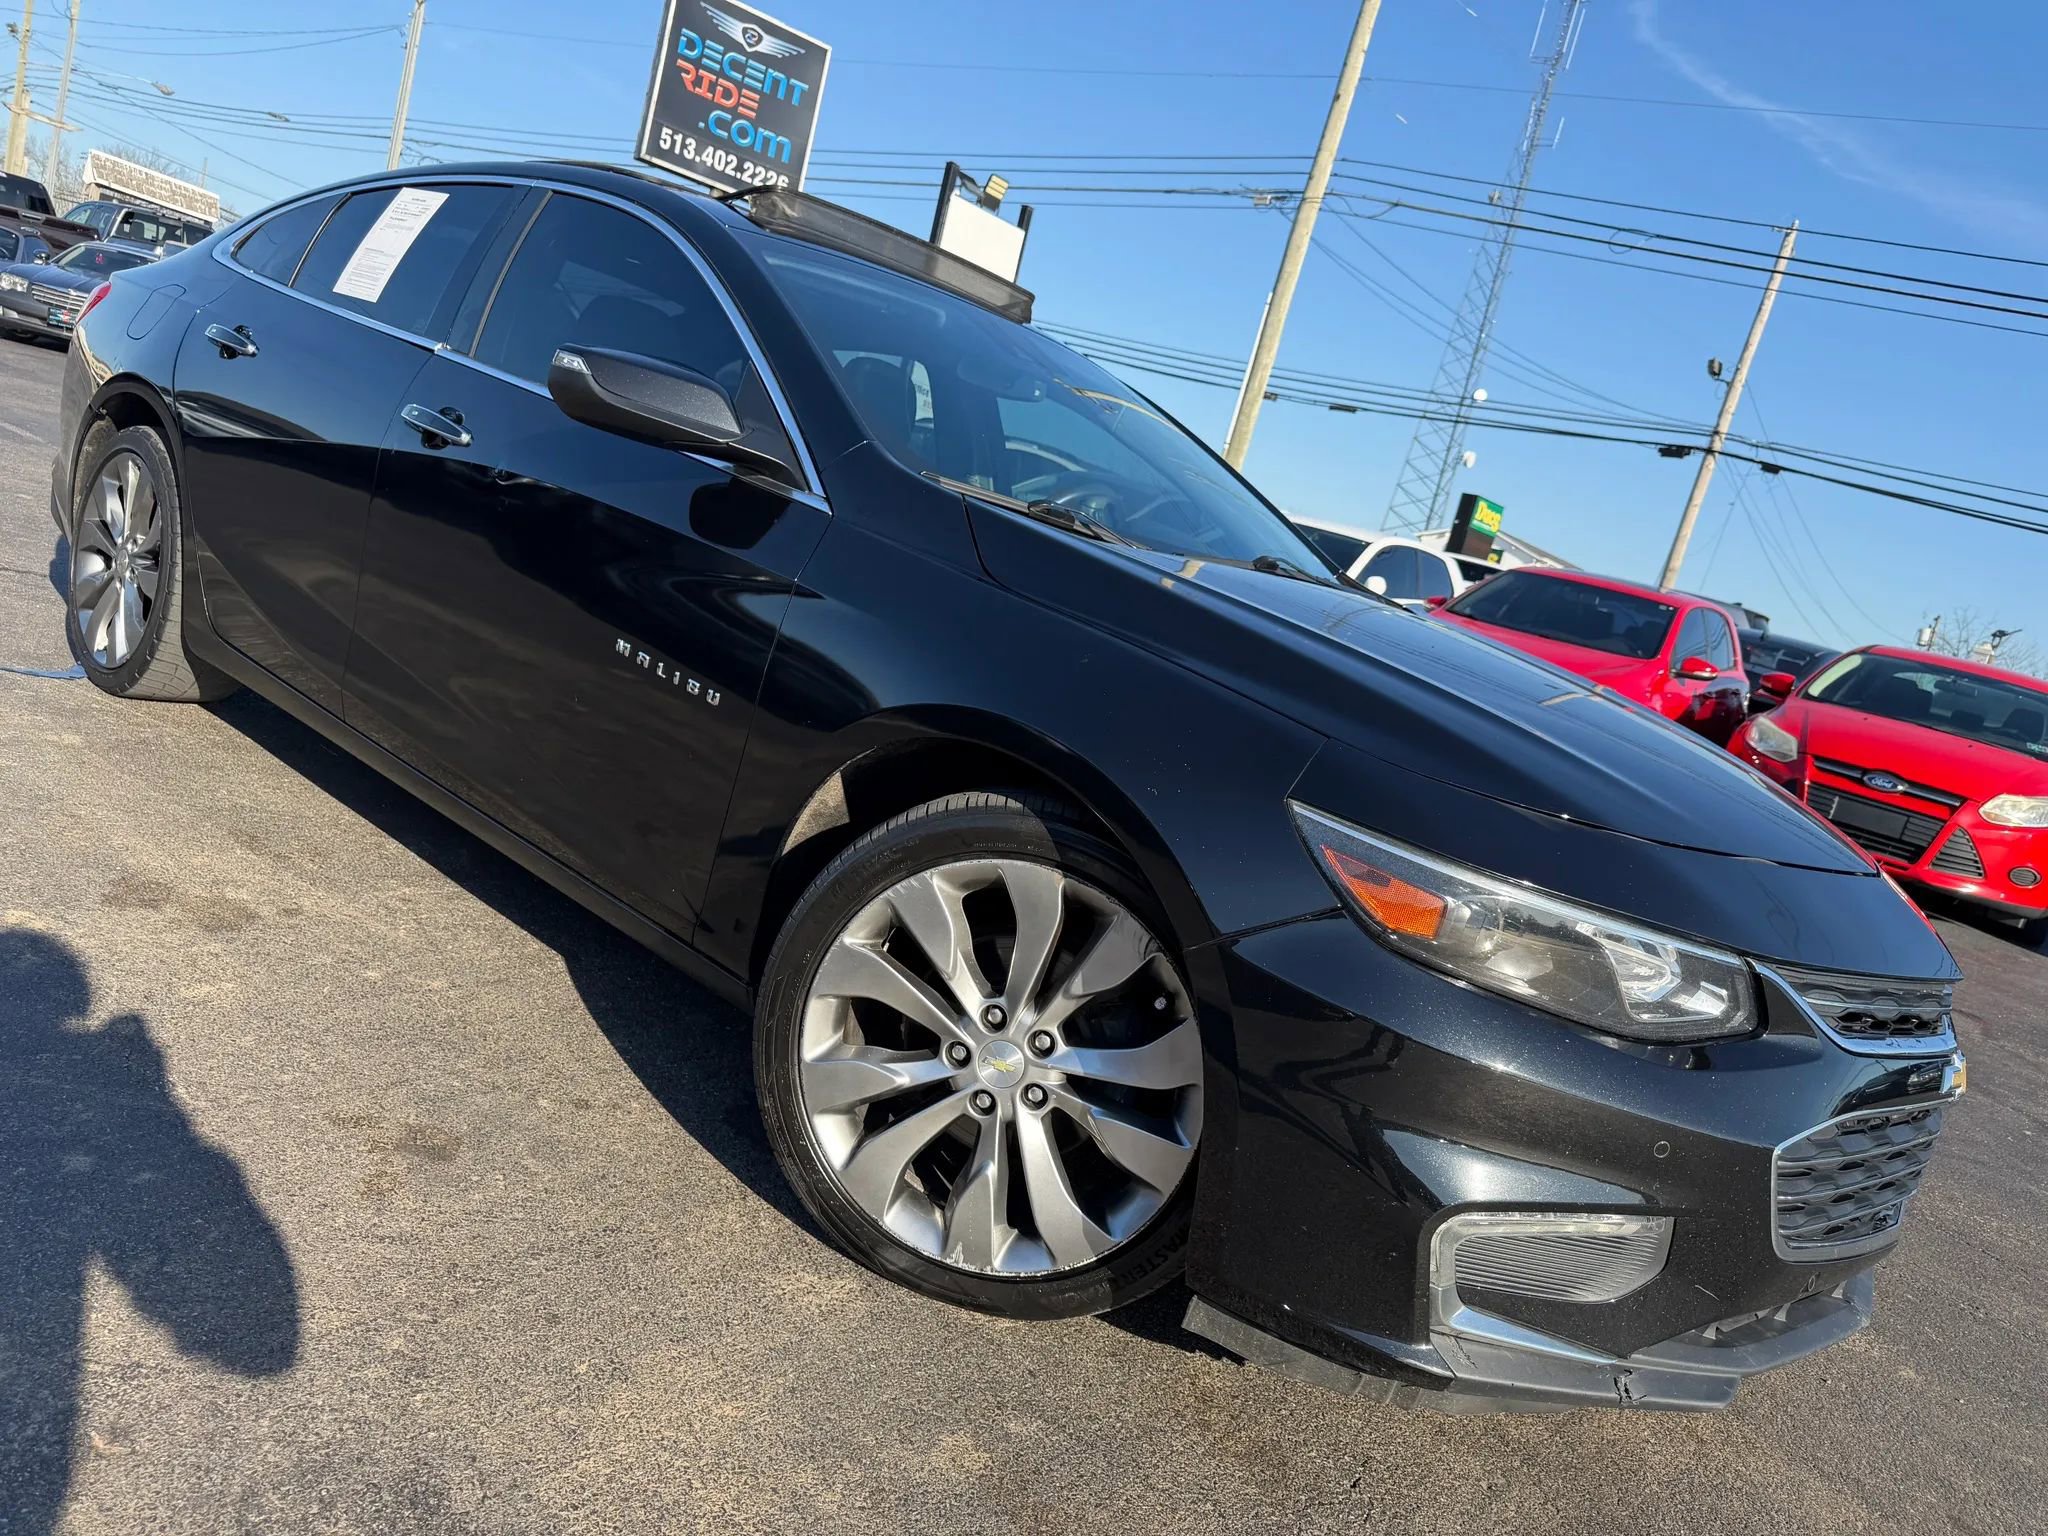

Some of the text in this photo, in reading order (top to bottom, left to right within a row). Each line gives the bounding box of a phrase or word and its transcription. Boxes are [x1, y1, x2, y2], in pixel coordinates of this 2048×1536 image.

[676, 59, 760, 119] RIDE
[615, 638, 721, 706] MALIBU
[1871, 776, 1894, 789] Ford
